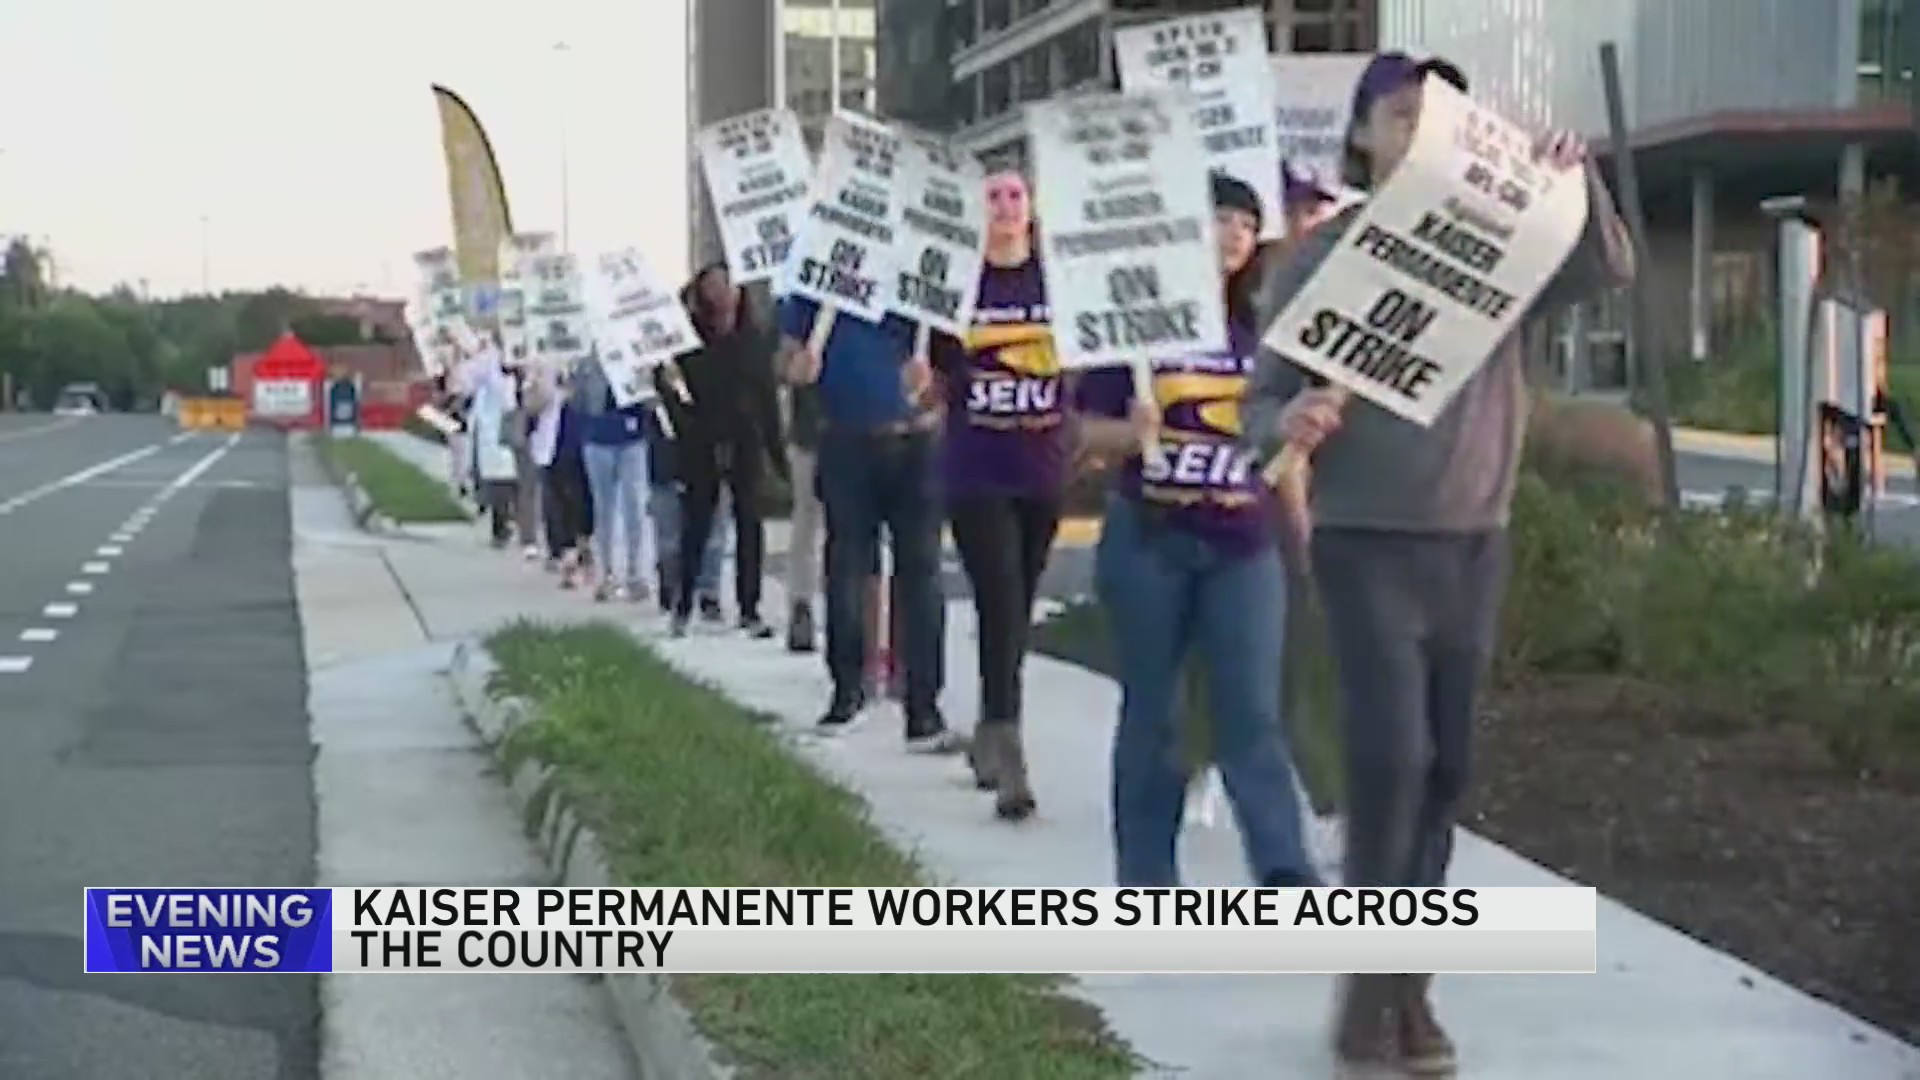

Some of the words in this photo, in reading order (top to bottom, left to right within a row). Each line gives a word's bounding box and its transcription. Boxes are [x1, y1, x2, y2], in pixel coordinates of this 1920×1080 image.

[757, 214, 789, 241] ON
[1414, 211, 1505, 275] KAISER
[831, 238, 863, 271] ON
[918, 246, 951, 283] ON
[1353, 224, 1517, 320] PERMANENTE
[798, 256, 879, 307] STRIKE
[1107, 264, 1160, 305] ON
[1076, 301, 1200, 352] STRIKE
[1367, 288, 1438, 341] ON
[1299, 309, 1442, 399] STRIKE
[966, 378, 1058, 414] SEIU
